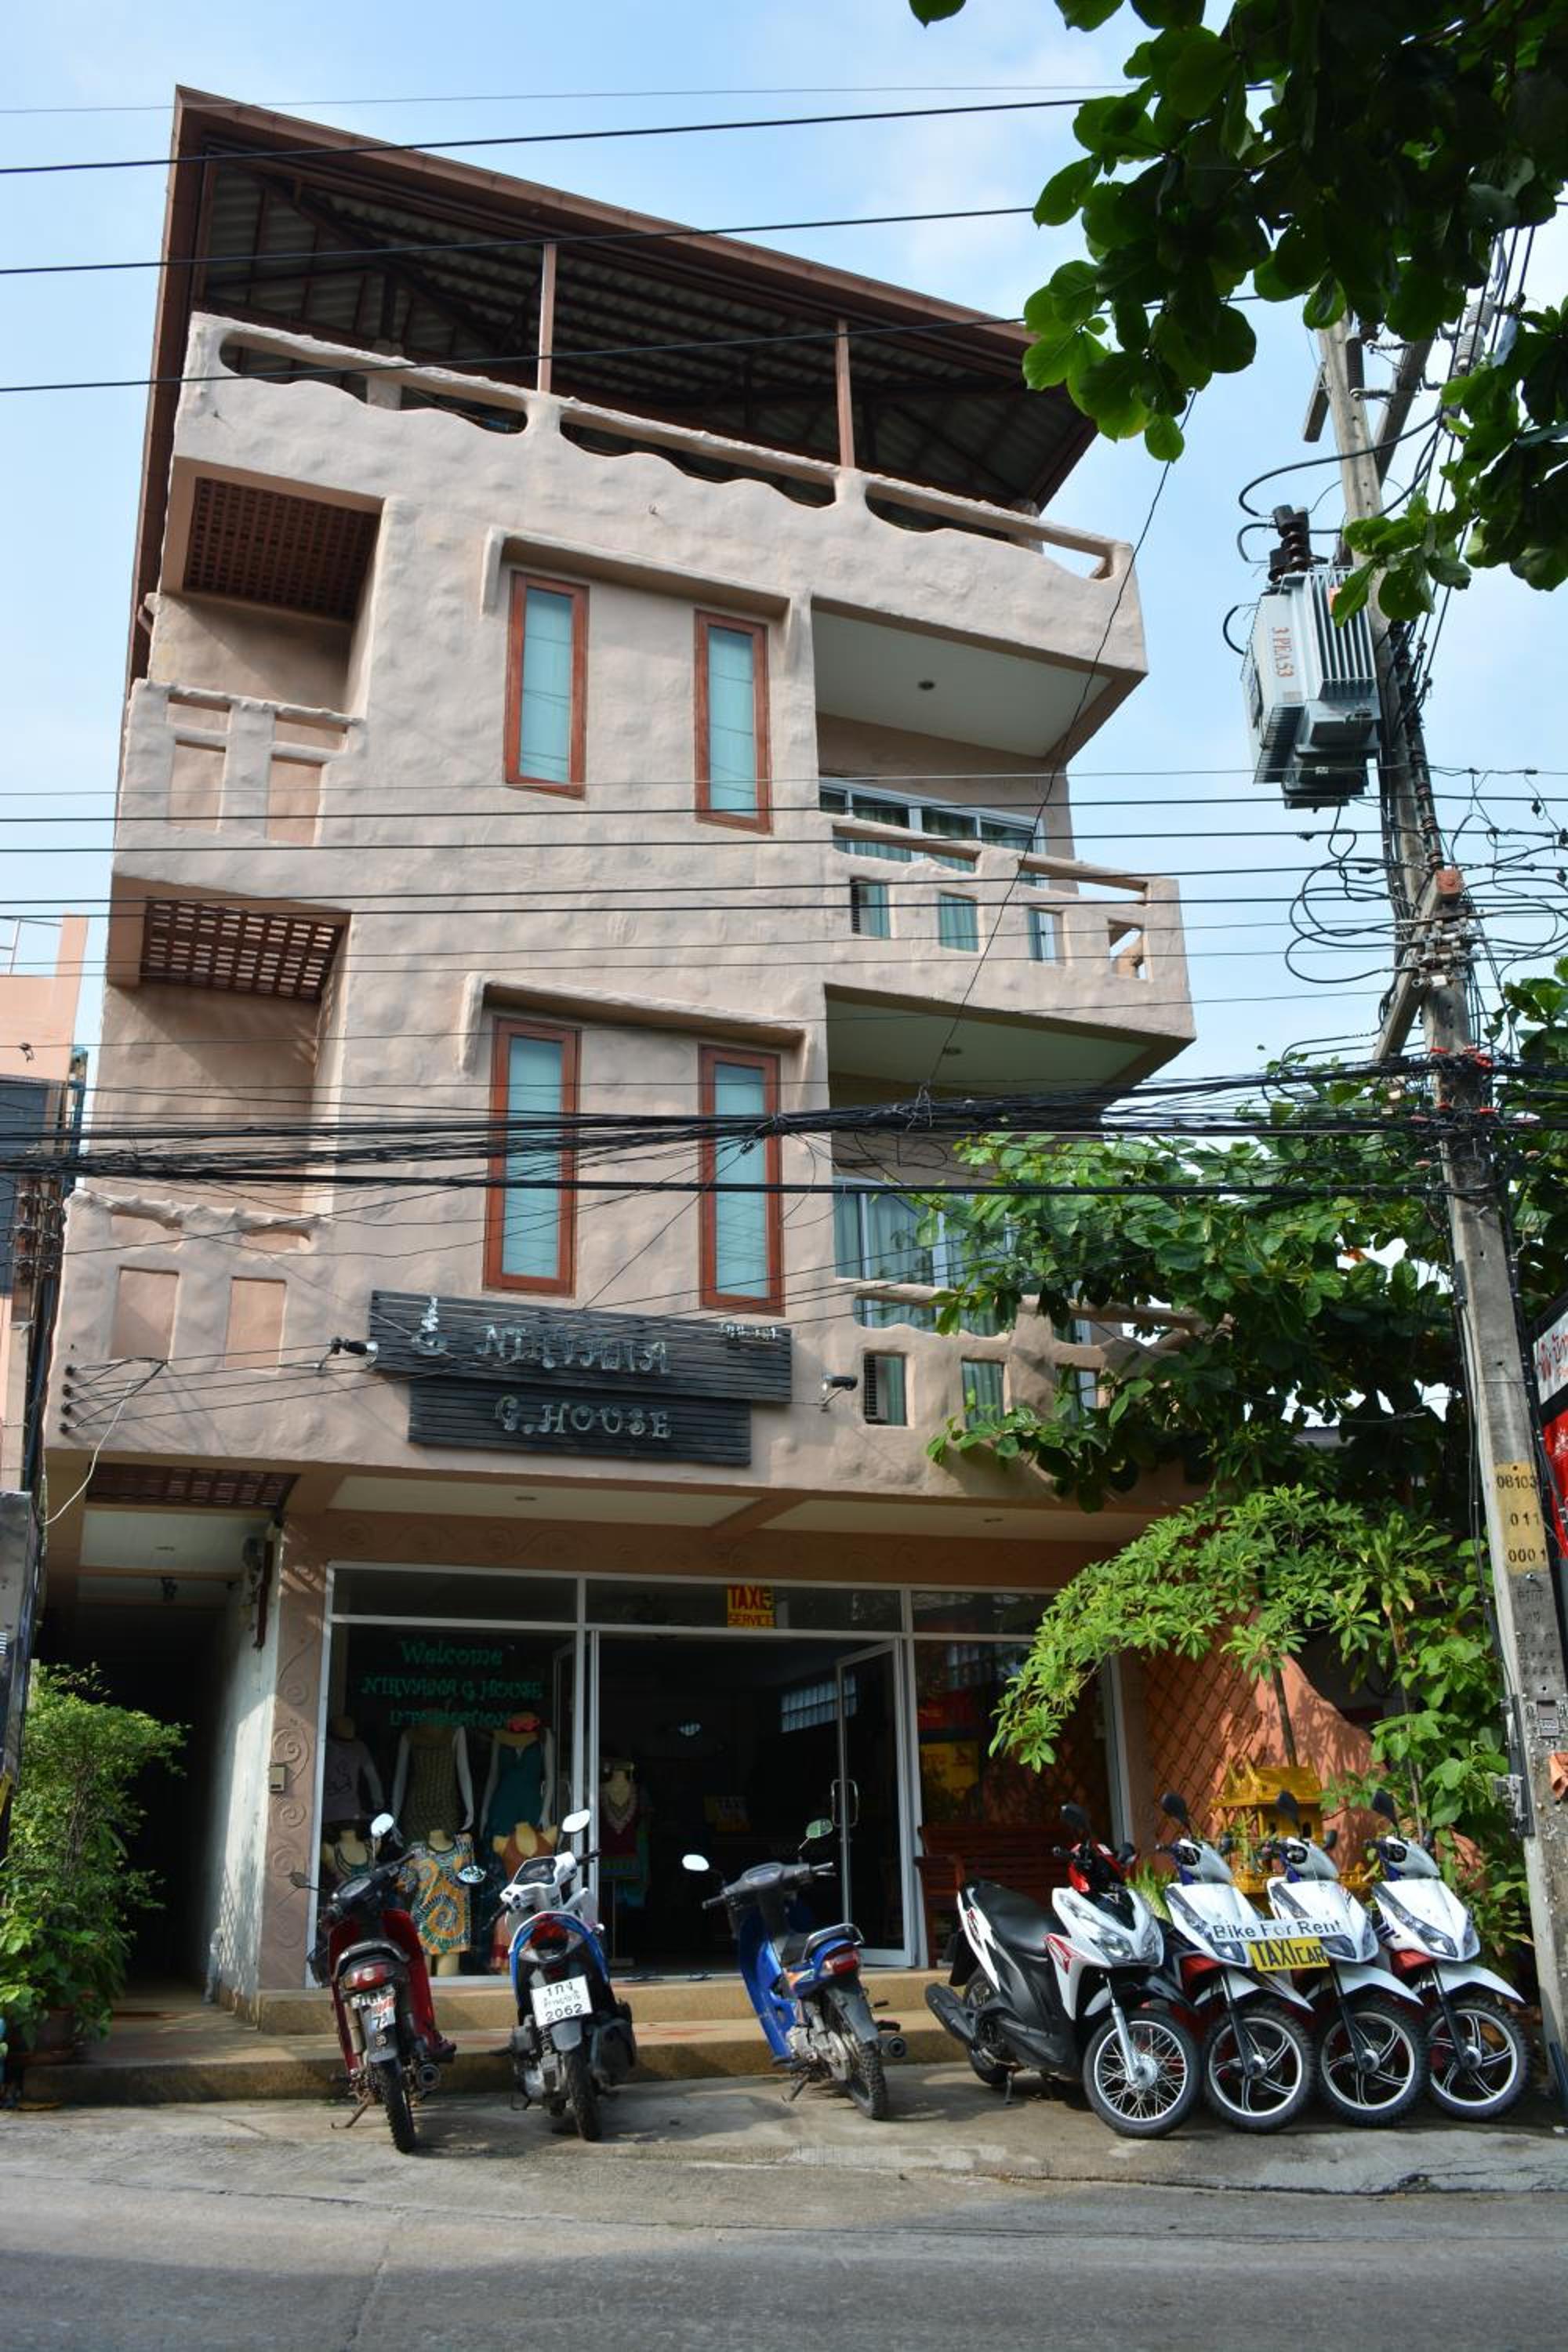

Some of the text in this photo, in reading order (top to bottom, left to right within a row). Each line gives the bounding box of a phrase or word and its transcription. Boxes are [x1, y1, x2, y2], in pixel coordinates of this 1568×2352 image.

[398, 1640, 502, 1665] Welcome
[1213, 1920, 1341, 1939] Bike For Rent
[1250, 1940, 1328, 1967] TAXI CAR
[545, 2003, 583, 2022] 2062
